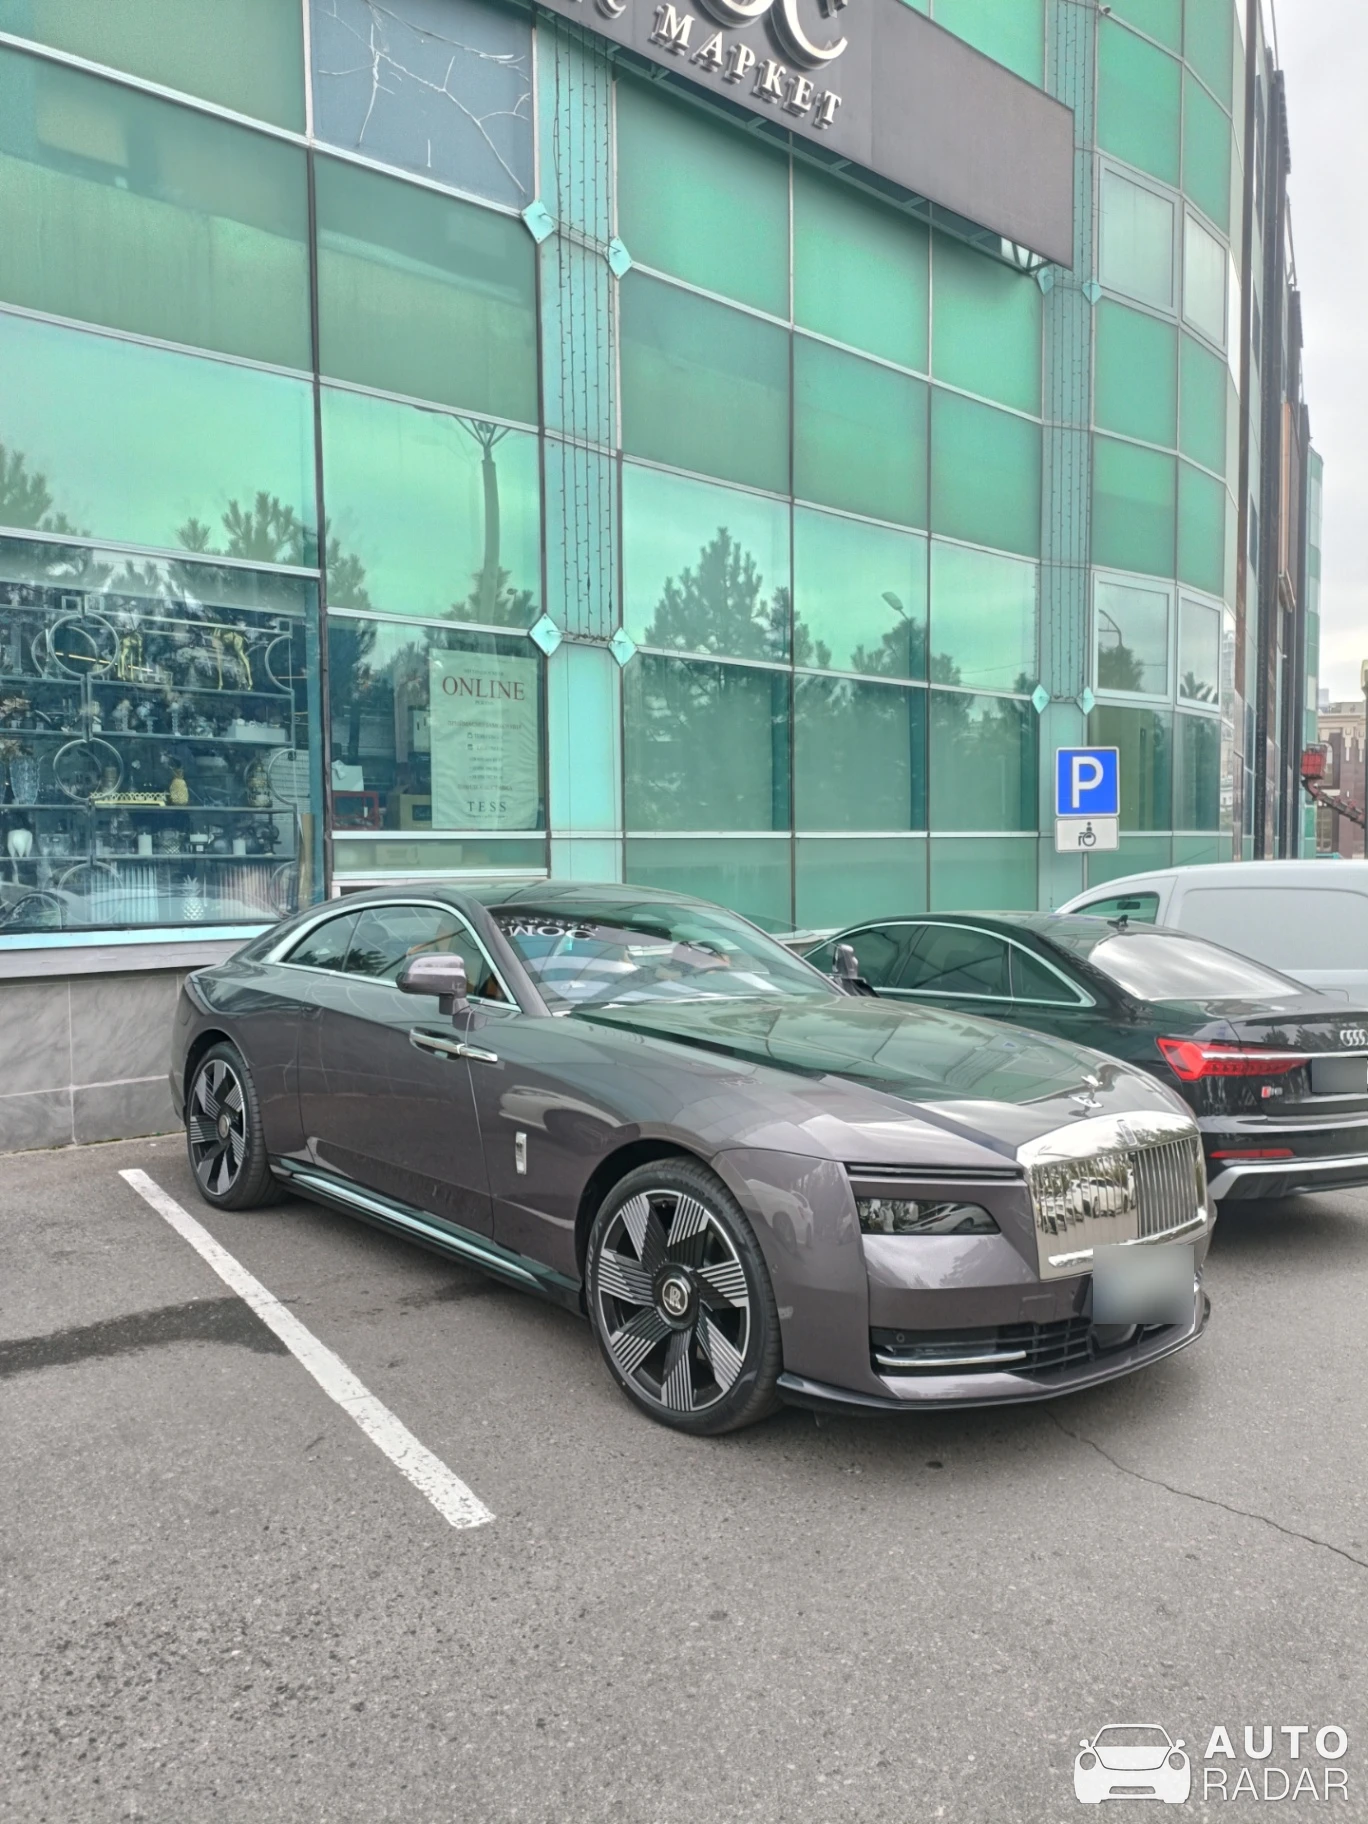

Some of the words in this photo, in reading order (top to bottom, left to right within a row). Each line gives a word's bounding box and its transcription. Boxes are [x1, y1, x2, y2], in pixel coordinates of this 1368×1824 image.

[653, 3, 843, 127] МАРКЕТ
[442, 675, 525, 701] ONLINE
[1072, 756, 1104, 808] P
[466, 801, 507, 813] TESS
